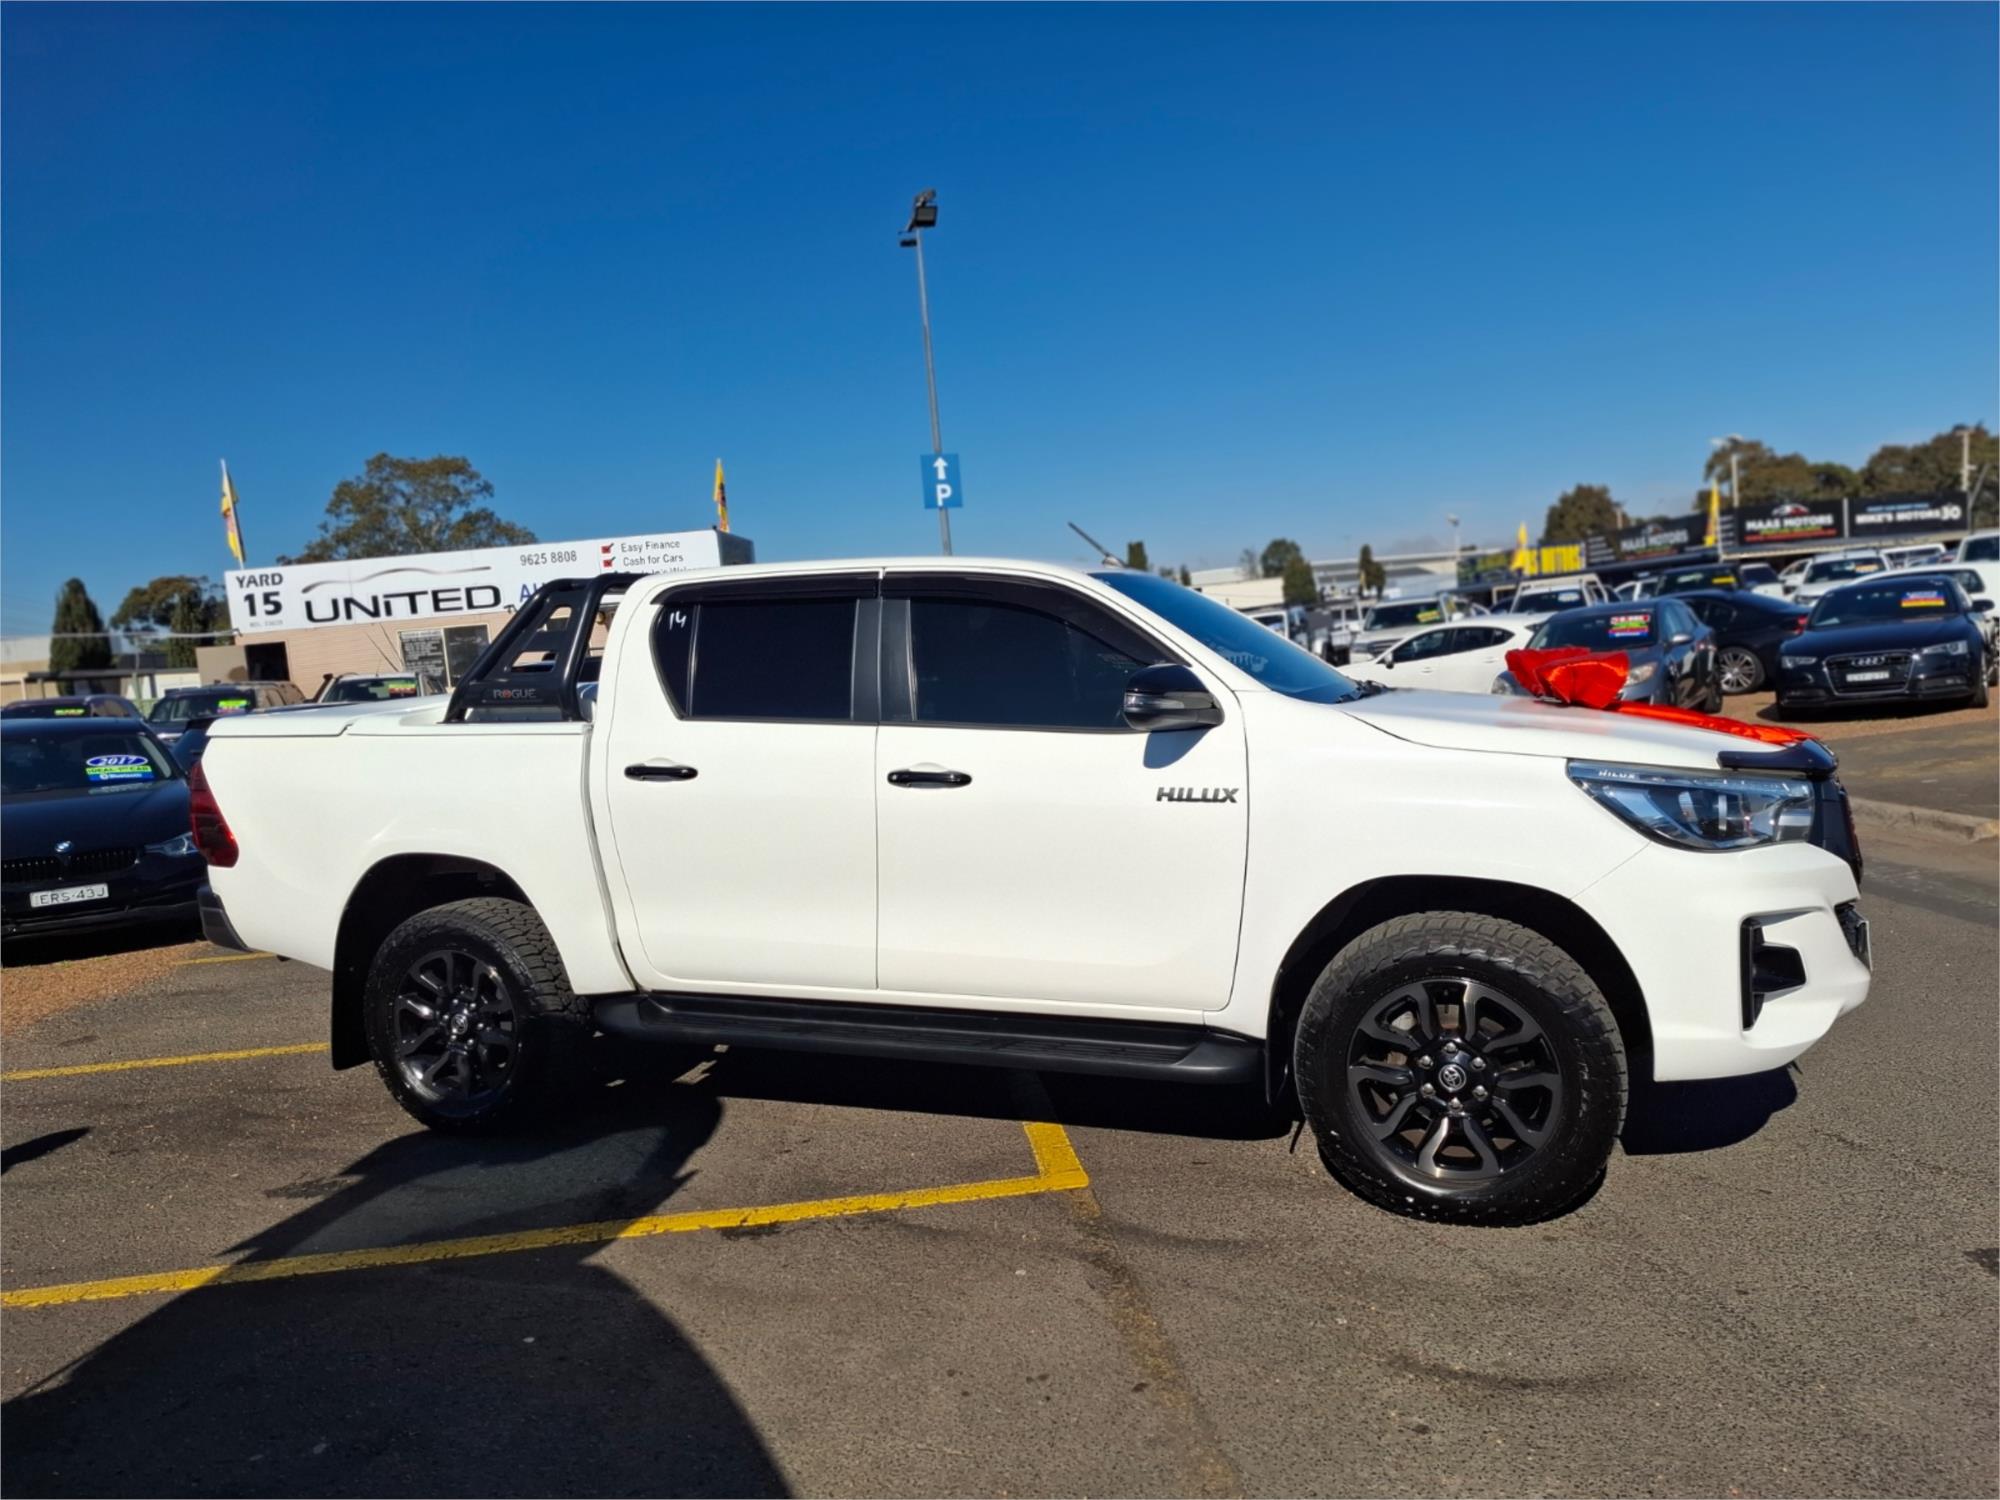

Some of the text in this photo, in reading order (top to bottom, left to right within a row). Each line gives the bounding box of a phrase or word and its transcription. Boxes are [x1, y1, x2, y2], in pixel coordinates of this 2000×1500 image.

[936, 484, 952, 506] P
[621, 540, 680, 552] Easy Finance
[520, 550, 577, 566] 9625 8808
[623, 553, 684, 566] Cash for Cars
[236, 572, 283, 588] YARD
[243, 591, 283, 617] 15
[669, 610, 687, 630] 14
[493, 688, 537, 699] ROGUE
[99, 757, 136, 765] 2017
[1599, 769, 1636, 779] HILUX
[1156, 786, 1240, 804] HILUX
